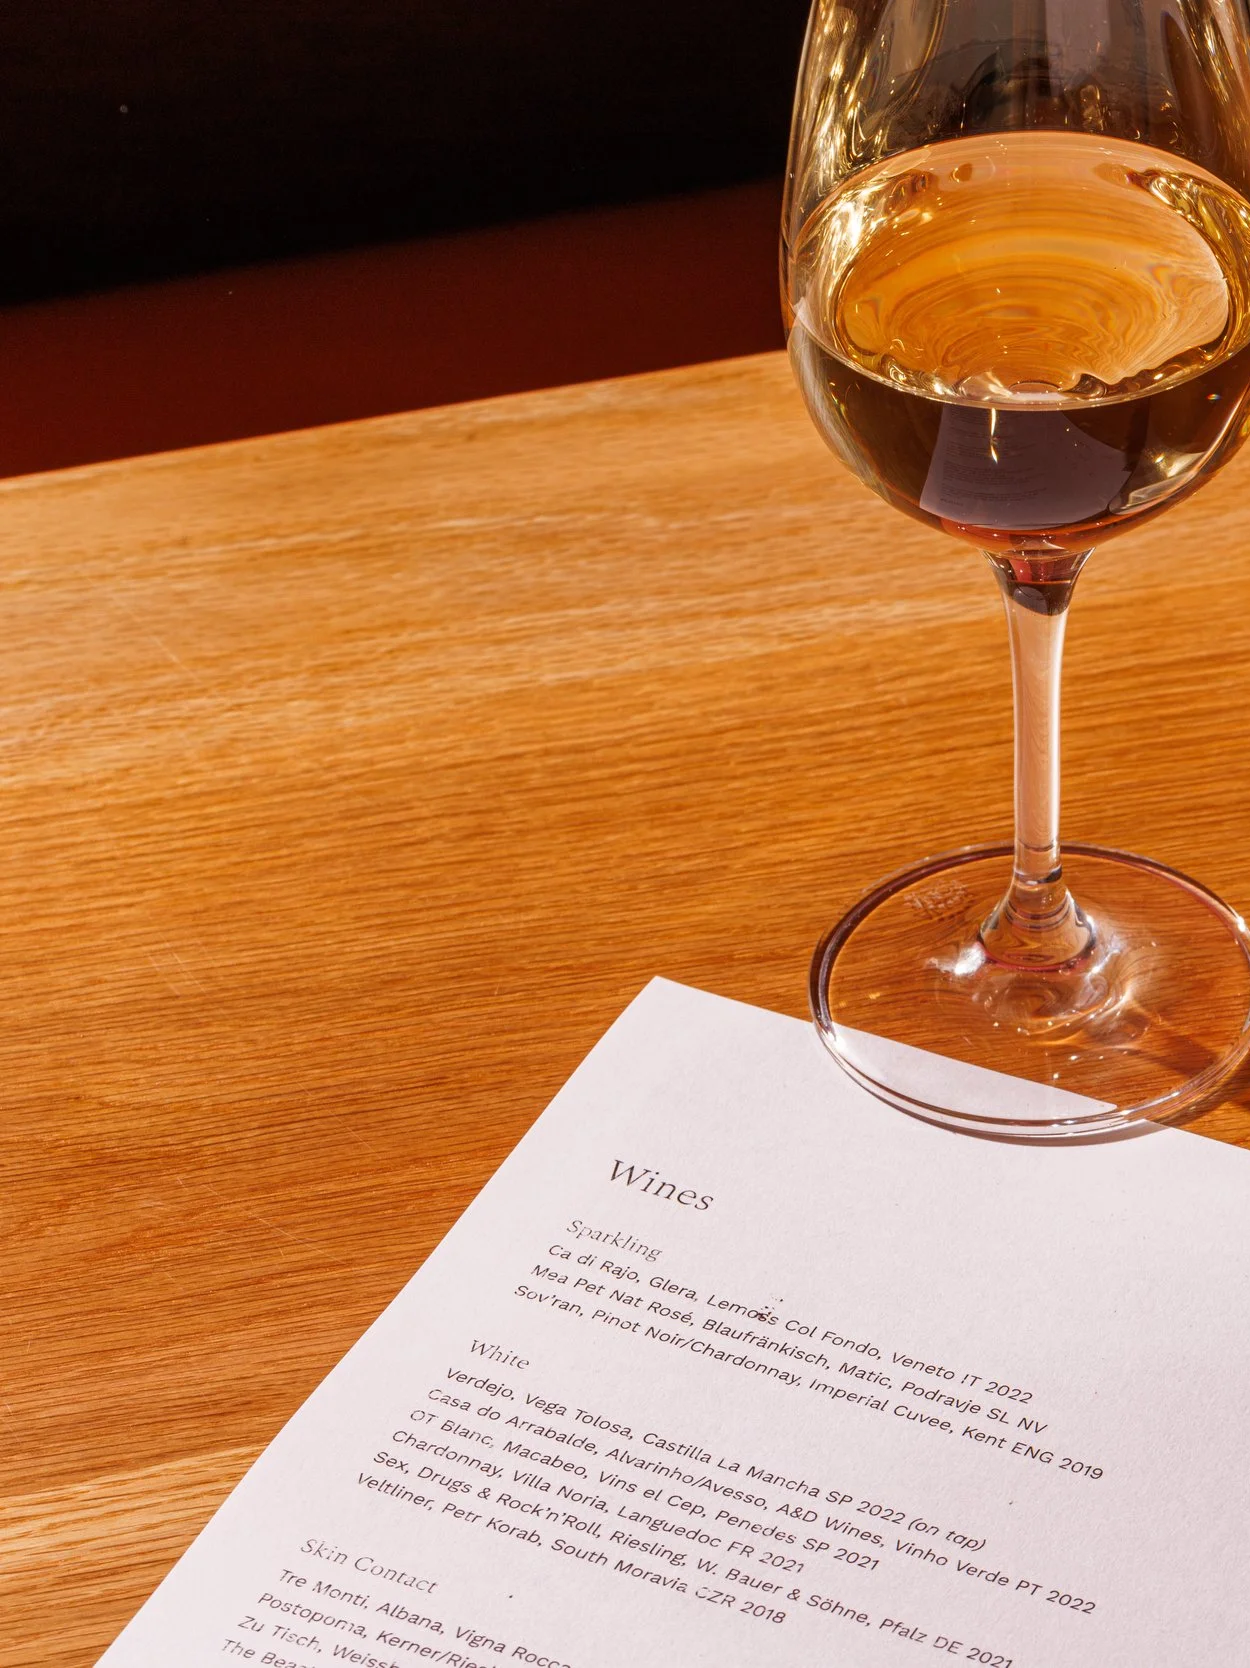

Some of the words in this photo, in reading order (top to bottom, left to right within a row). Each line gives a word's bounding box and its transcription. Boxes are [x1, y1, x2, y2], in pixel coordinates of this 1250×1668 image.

[565, 1219, 664, 1263] Sparkling
[609, 1159, 715, 1211] Wines
[469, 1339, 530, 1370] White
[513, 1285, 584, 1318] Sov’ran,
[591, 1309, 642, 1333] Pinot
[643, 1326, 803, 1387] Noir/Chardonnay,
[808, 1378, 890, 1412] Imperial
[893, 1404, 954, 1435] Cuvee,
[961, 1425, 1008, 1449] Kent
[1010, 1441, 1055, 1465] ENG
[1058, 1457, 1104, 1480] 2019
[530, 1264, 569, 1285] Mea
[572, 1277, 606, 1296] Pet
[608, 1289, 644, 1308] Nat
[646, 1301, 695, 1327] Rosé,
[701, 1318, 831, 1371] Blaufränkisch,
[838, 1362, 893, 1390] Matic,
[900, 1381, 982, 1414] Podravje
[986, 1407, 1010, 1425] SL
[1016, 1417, 1049, 1434] NV
[548, 1244, 572, 1261] Ca
[576, 1254, 598, 1267] di
[599, 1260, 641, 1284] Rajo,
[649, 1276, 699, 1303] Glera,
[784, 1319, 819, 1338] Col
[820, 1330, 882, 1361] Fondo,
[892, 1351, 956, 1381] Veneto
[960, 1373, 983, 1387] IT
[984, 1381, 1034, 1405] 2022
[391, 1430, 504, 1479] Chardonnay,
[513, 1469, 552, 1493] Villa
[555, 1485, 609, 1514] Noria,
[616, 1505, 722, 1548] Languedoc
[726, 1540, 755, 1558] FR
[758, 1551, 805, 1574] 2021
[409, 1409, 439, 1425] OT
[439, 1419, 494, 1449] Blanc,
[502, 1440, 588, 1480] Macabeo,
[598, 1470, 638, 1493] Vins
[642, 1488, 664, 1502] el
[666, 1494, 707, 1519] Cep,
[714, 1509, 798, 1545] Penedes
[802, 1537, 831, 1553] SP
[832, 1547, 880, 1571] 2021
[427, 1388, 472, 1412] Casa
[476, 1405, 502, 1421] do
[504, 1415, 599, 1456] Arrabalde,
[604, 1448, 768, 1511] Alvarinho/Avesso,
[775, 1503, 819, 1523] A&D
[824, 1516, 885, 1548] Wines,
[895, 1539, 949, 1566] Vinho
[956, 1559, 1010, 1587] Verde
[1014, 1579, 1044, 1596] PT
[1045, 1589, 1097, 1615] 2022
[525, 1392, 568, 1417] Vega
[574, 1408, 634, 1441] Tolosa,
[642, 1432, 712, 1464] Castilla
[716, 1457, 741, 1473] La
[745, 1465, 821, 1498] Mancha
[825, 1490, 854, 1505] SP
[855, 1500, 907, 1525] 2022
[907, 1517, 941, 1536] (on
[944, 1530, 987, 1552] tap)
[257, 1592, 368, 1639] Postopoma,
[279, 1568, 308, 1588] Tre
[375, 1602, 445, 1636] Albana,
[455, 1626, 507, 1654] Vigna
[299, 1538, 349, 1565] Skin
[353, 1556, 439, 1594] Contact
[357, 1472, 436, 1511] Veltliner,
[441, 1502, 483, 1524] Petr
[485, 1517, 543, 1547] Korab,
[550, 1538, 609, 1566] South
[613, 1559, 689, 1594] Moravia
[694, 1586, 737, 1608] CZR
[739, 1600, 787, 1624] 2018
[372, 1451, 410, 1475] Sex,
[416, 1466, 473, 1494] Drugs
[476, 1487, 492, 1501] &
[608, 1530, 688, 1567] Riesling,
[696, 1557, 719, 1576] W.
[724, 1567, 784, 1595] Bauer
[786, 1588, 801, 1602] &
[805, 1594, 871, 1627] Söhne,
[878, 1617, 928, 1644] Pfalz
[932, 1635, 964, 1655] DE
[221, 1638, 256, 1659] The
[237, 1615, 266, 1633] Zu
[272, 1624, 322, 1654] Tisch,
